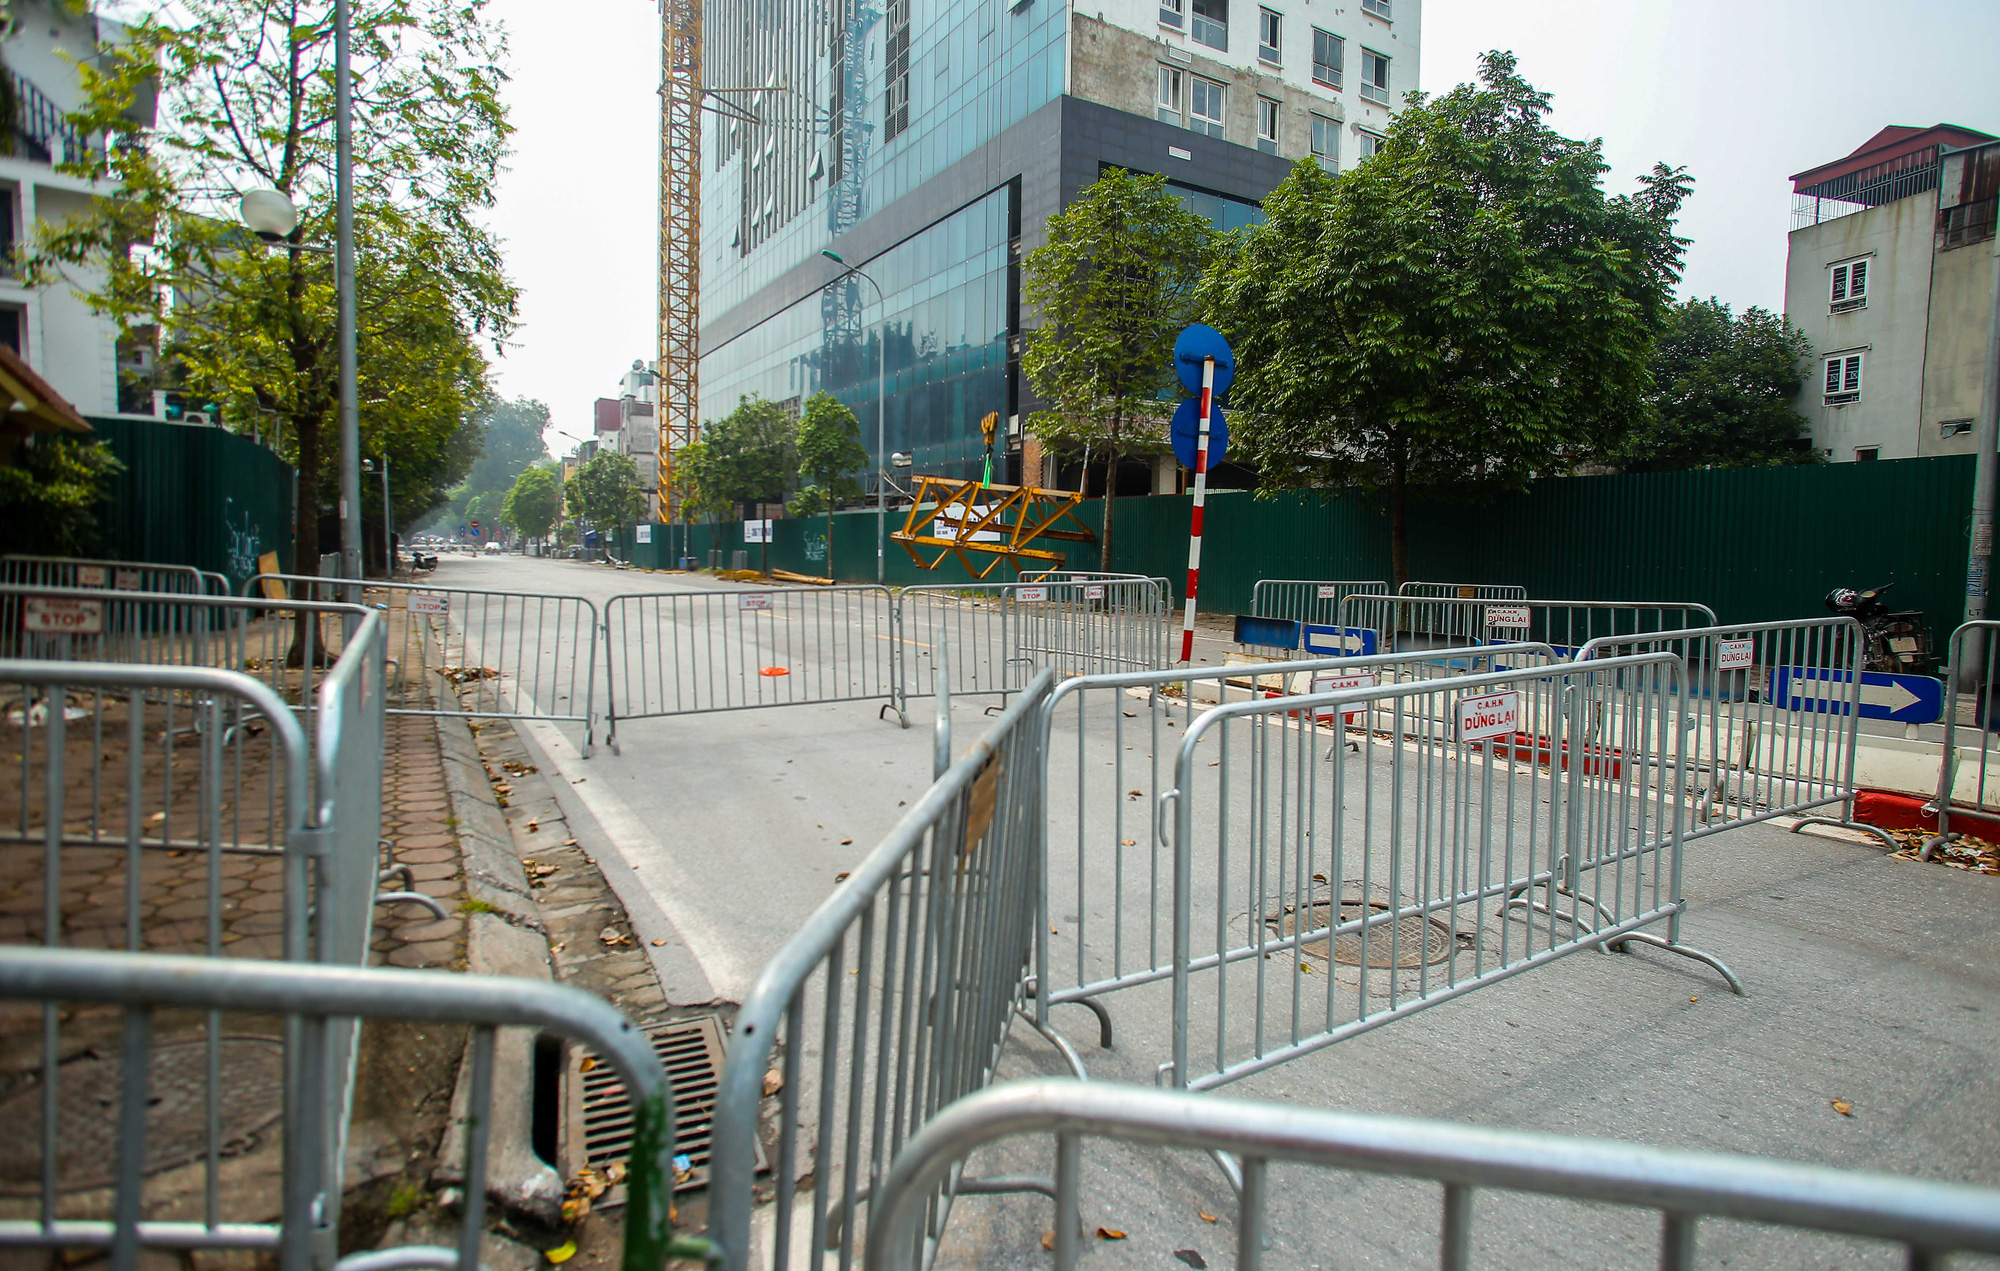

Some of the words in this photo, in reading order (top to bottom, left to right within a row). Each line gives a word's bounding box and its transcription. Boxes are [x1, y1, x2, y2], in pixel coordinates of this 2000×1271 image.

[415, 603, 441, 611] STOP
[745, 600, 767, 608] STOP
[40, 612, 87, 627] STOP
[1477, 698, 1504, 710] C.A.H.N
[1465, 711, 1496, 731] DỪNG
